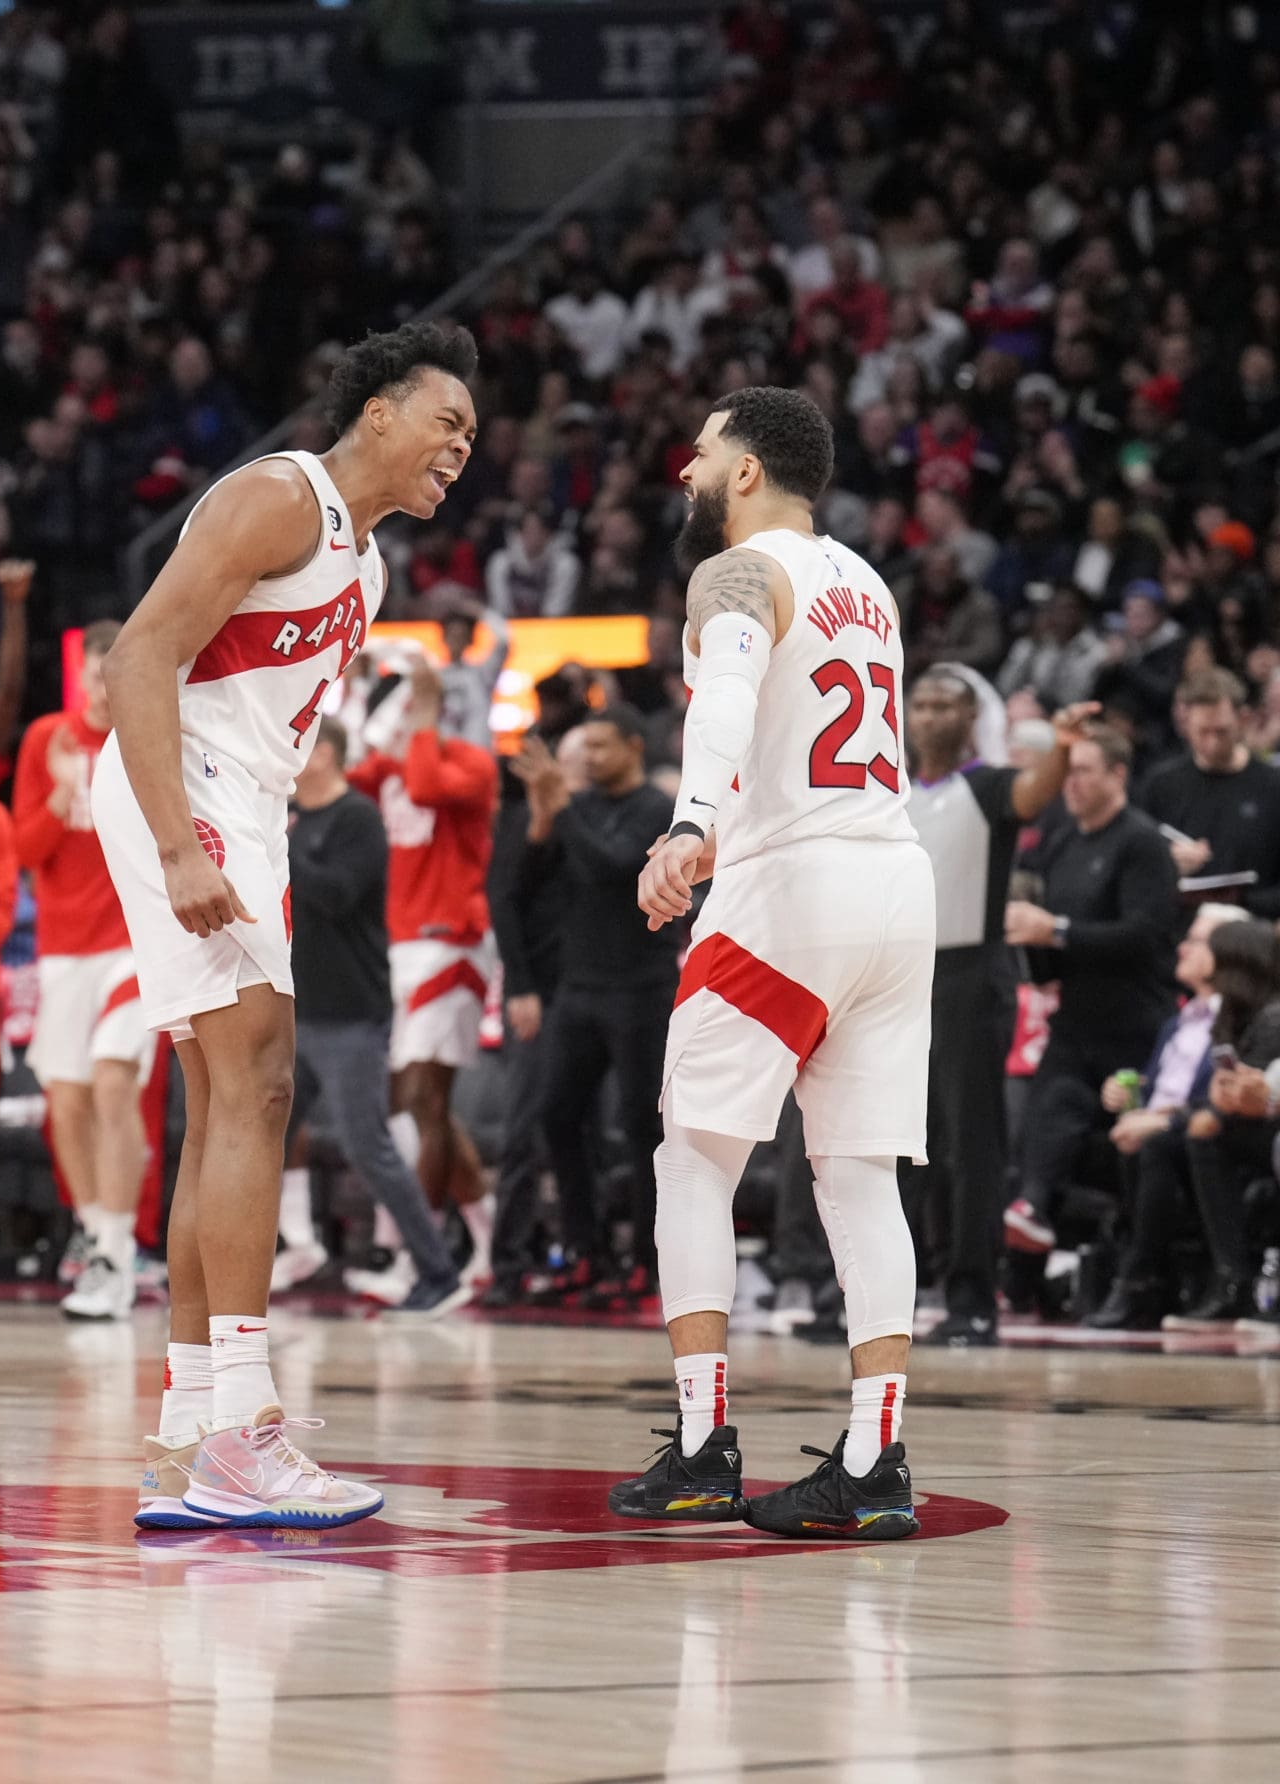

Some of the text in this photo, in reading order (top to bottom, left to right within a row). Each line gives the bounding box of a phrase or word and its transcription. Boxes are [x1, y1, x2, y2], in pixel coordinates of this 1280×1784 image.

[807, 586, 892, 646] VANVLEET
[289, 678, 329, 749] 4
[809, 658, 899, 794] 23
